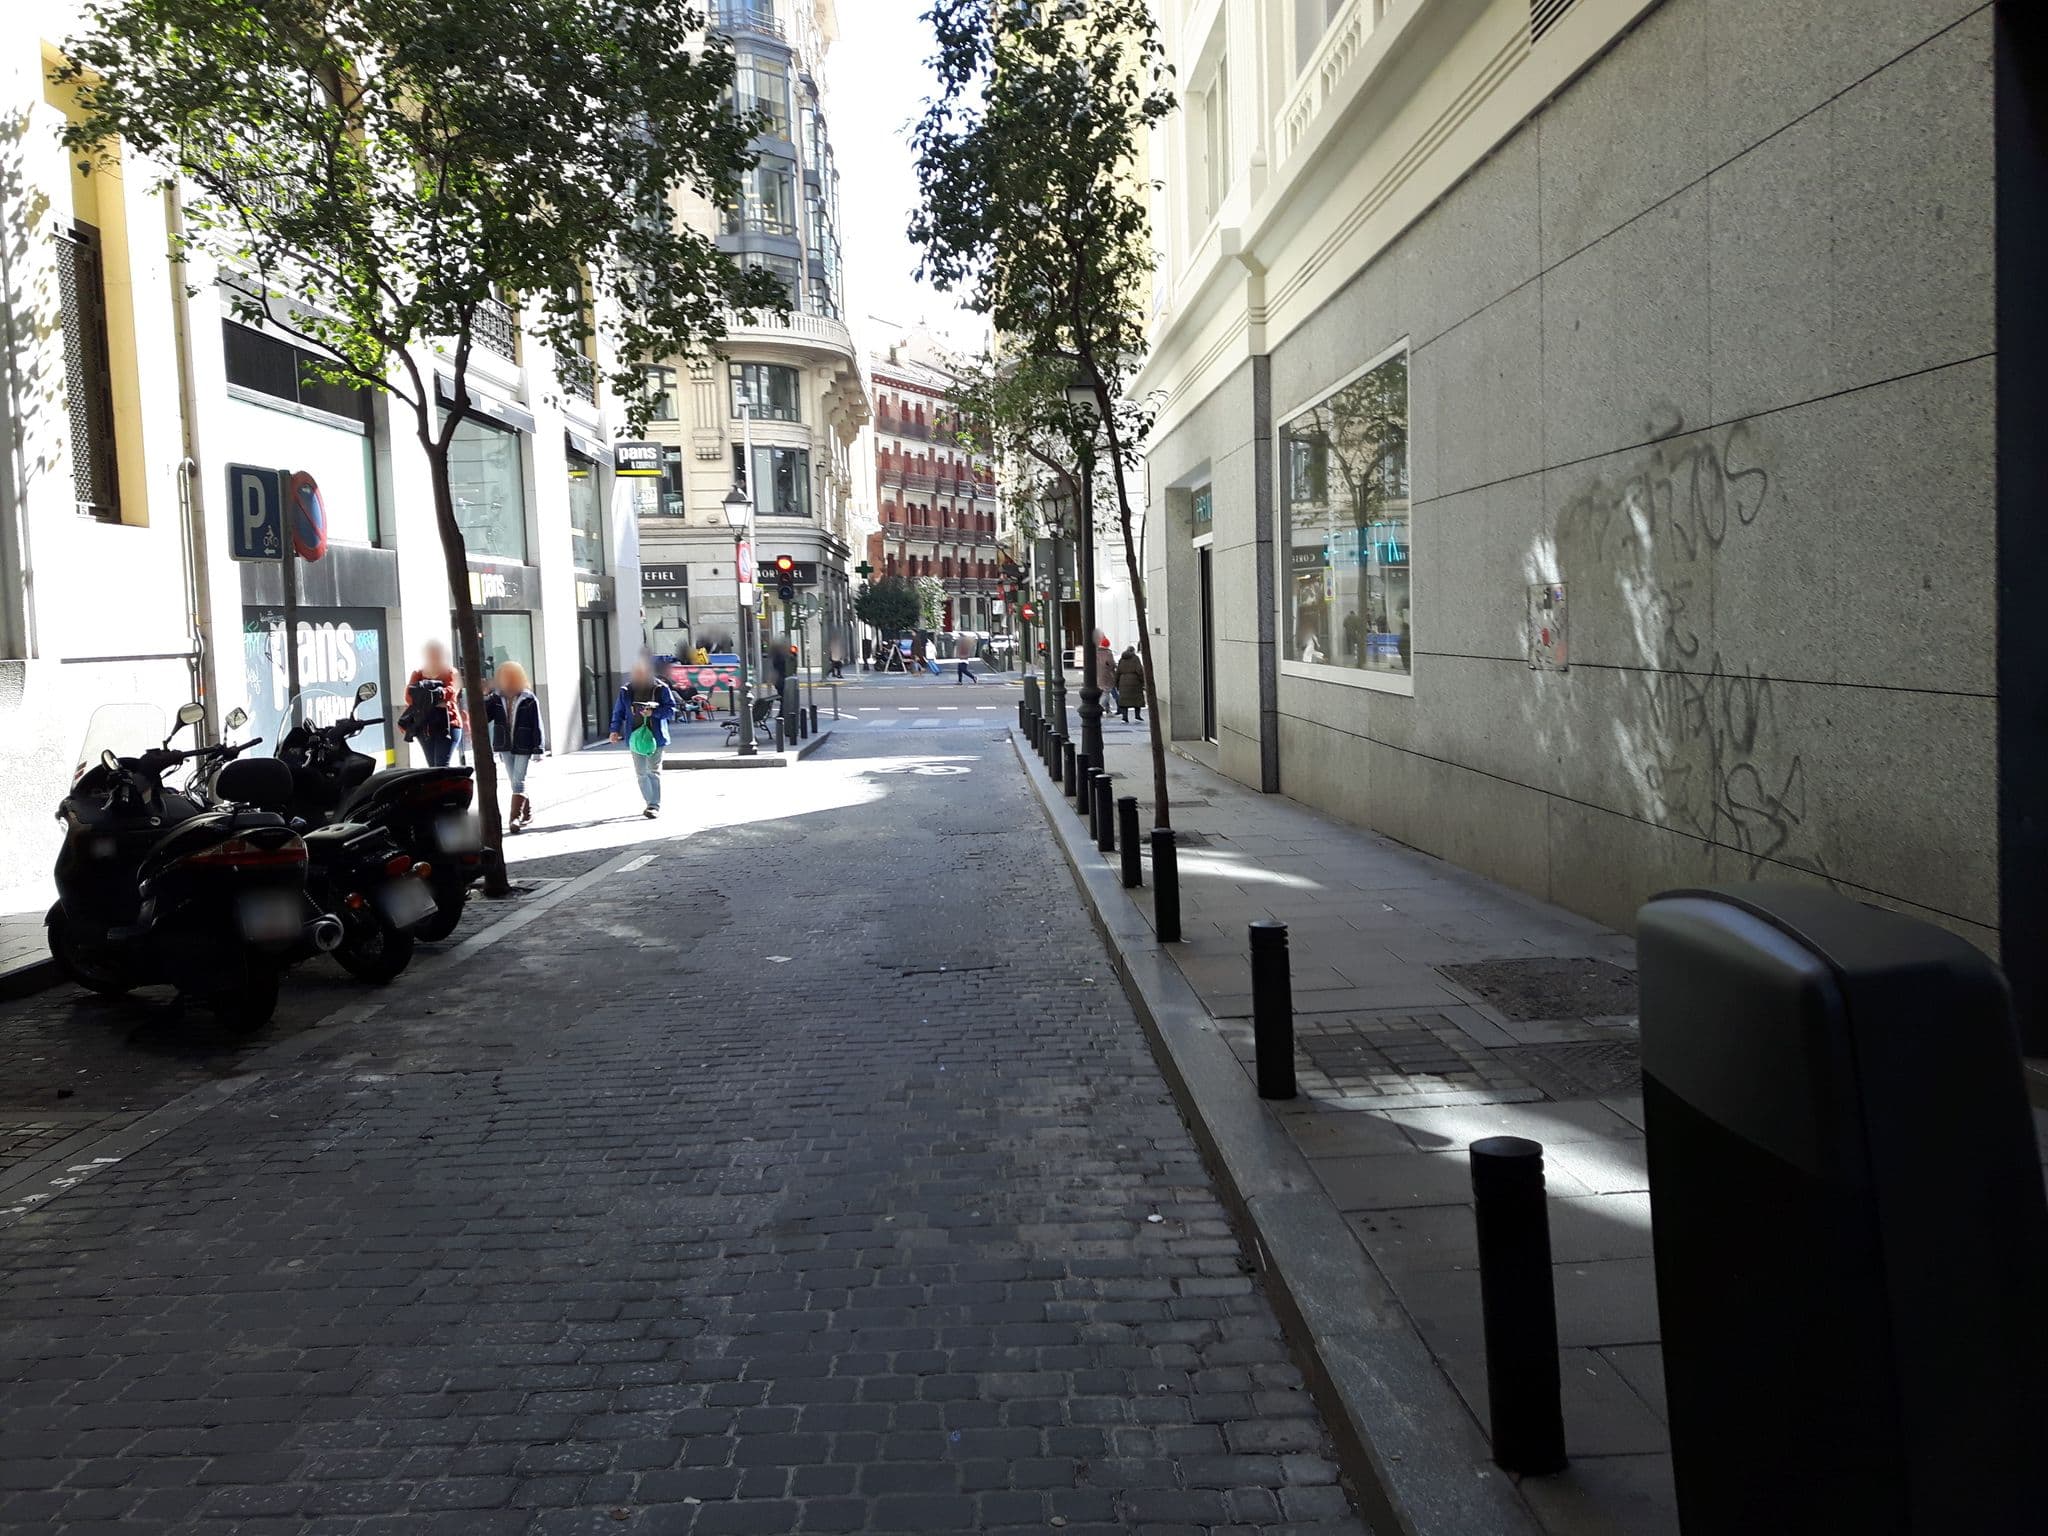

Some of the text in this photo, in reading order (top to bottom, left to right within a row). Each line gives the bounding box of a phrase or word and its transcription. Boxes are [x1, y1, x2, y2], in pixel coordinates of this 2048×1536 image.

[618, 447, 657, 463] pans
[241, 474, 266, 549] P
[480, 573, 505, 605] pans
[643, 571, 676, 581] EFIEL
[269, 621, 357, 711] pans
